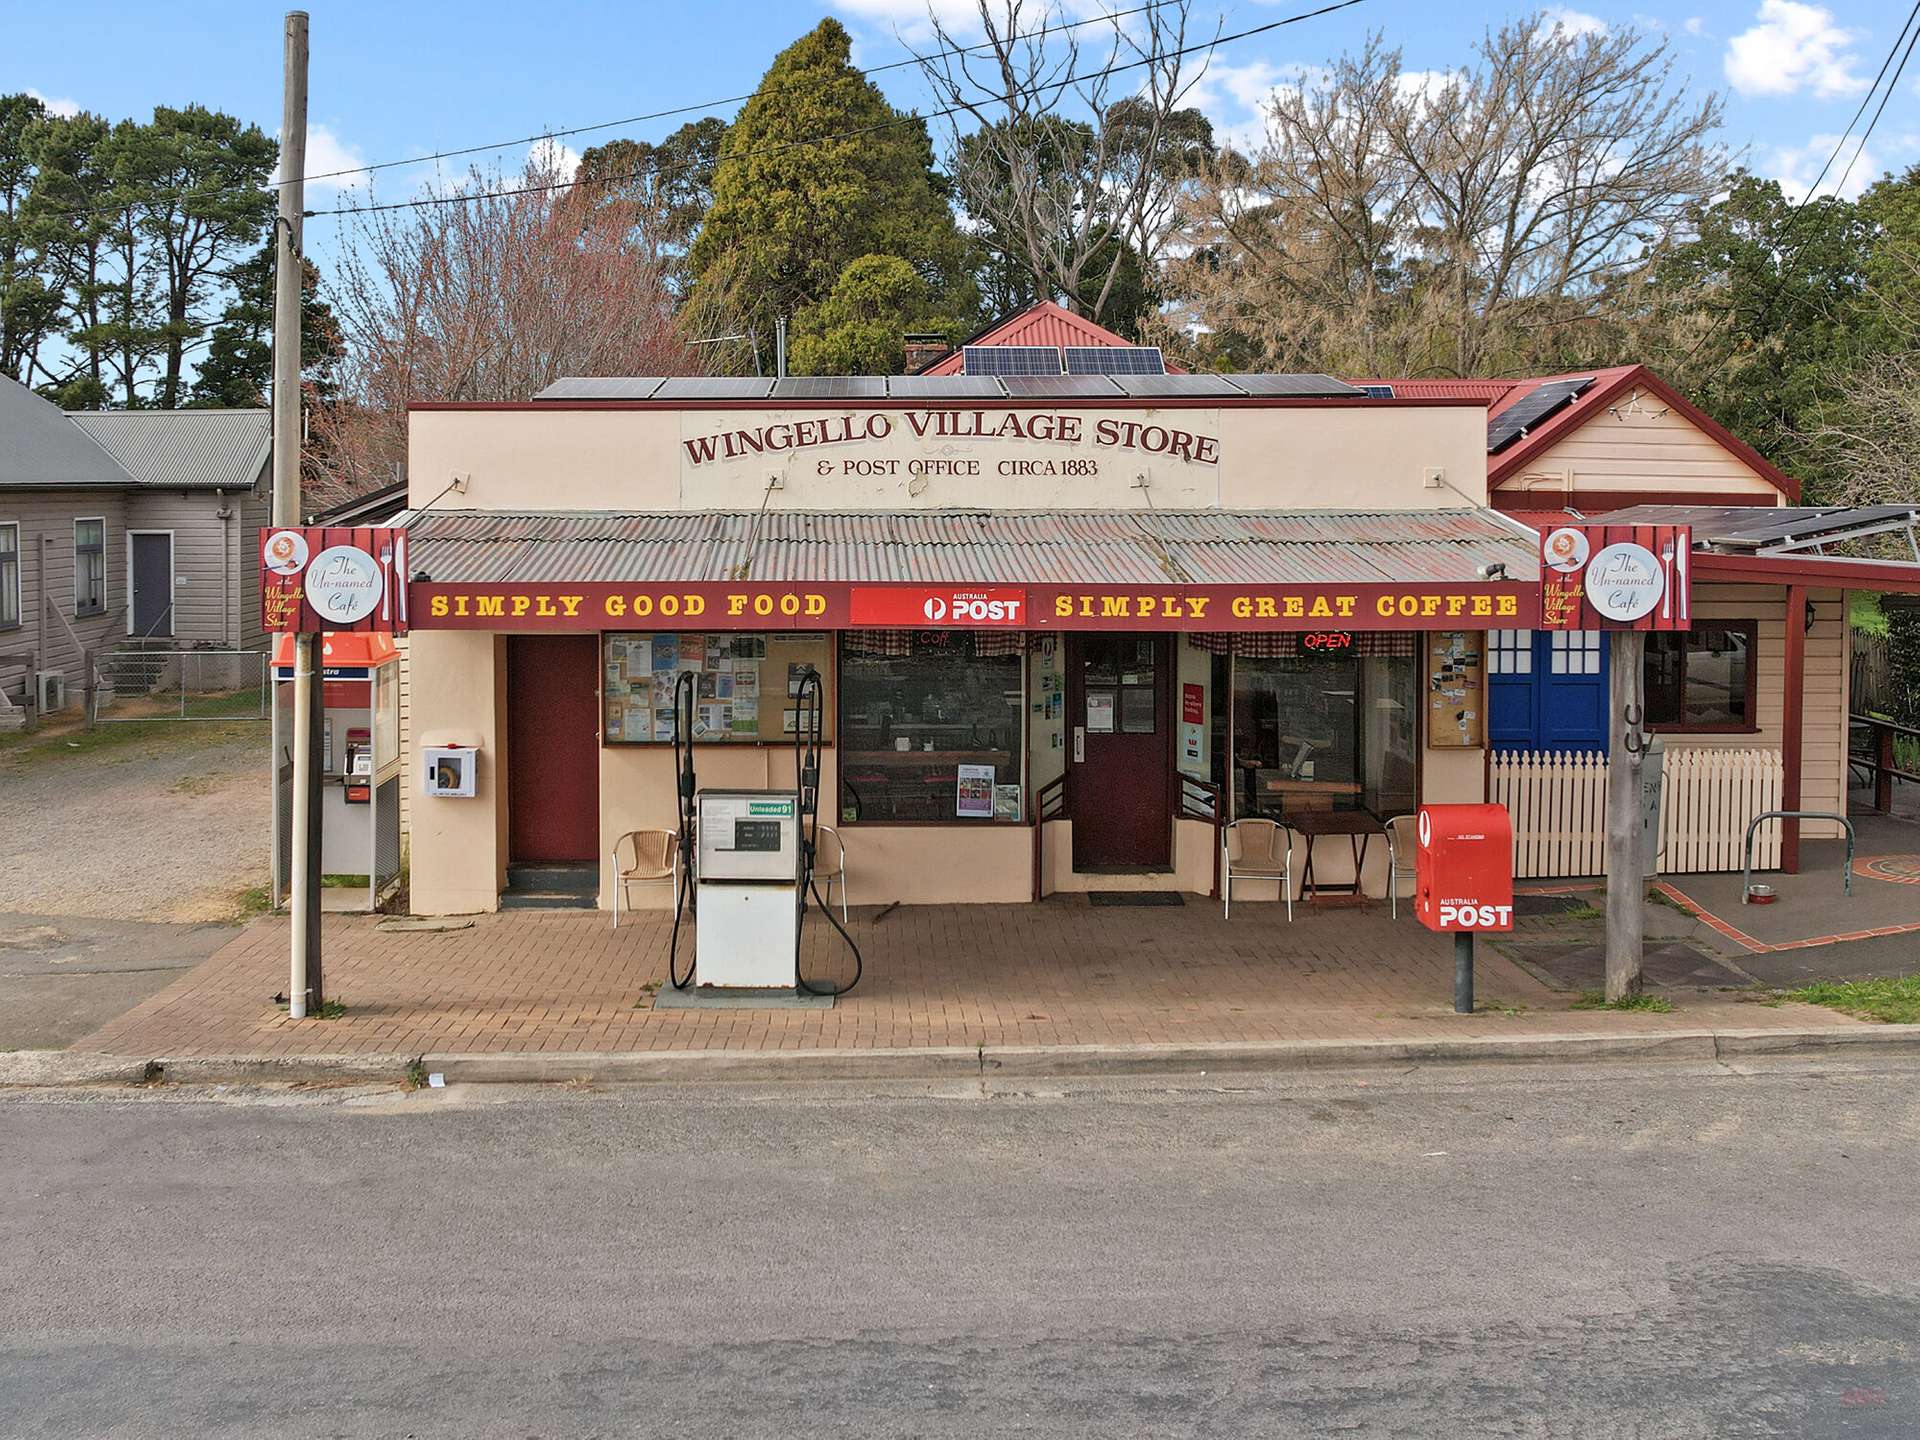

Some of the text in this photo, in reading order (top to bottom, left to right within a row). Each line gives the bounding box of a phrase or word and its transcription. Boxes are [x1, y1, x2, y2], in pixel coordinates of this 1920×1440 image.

[683, 411, 1219, 466] WINGELLO VILLAGE STORE
[816, 459, 1098, 476] & POST OFFICE CIRCA 1883
[330, 555, 357, 576] The
[1611, 553, 1638, 573] The
[311, 569, 376, 589] Un-named
[1591, 567, 1657, 587] Un-named
[264, 586, 304, 602] Wingello
[1543, 583, 1584, 600] Wingello
[264, 600, 296, 616] Village
[431, 593, 827, 617] SIMPLY GOOD FOOD
[952, 600, 1020, 620] POST
[1054, 595, 1518, 617] SIMPLY GREAT COFFEE
[1543, 597, 1576, 613] Village
[264, 613, 289, 626] Store
[1543, 610, 1568, 624] Store
[1303, 634, 1352, 648] OPEN
[1440, 905, 1512, 927] POST
